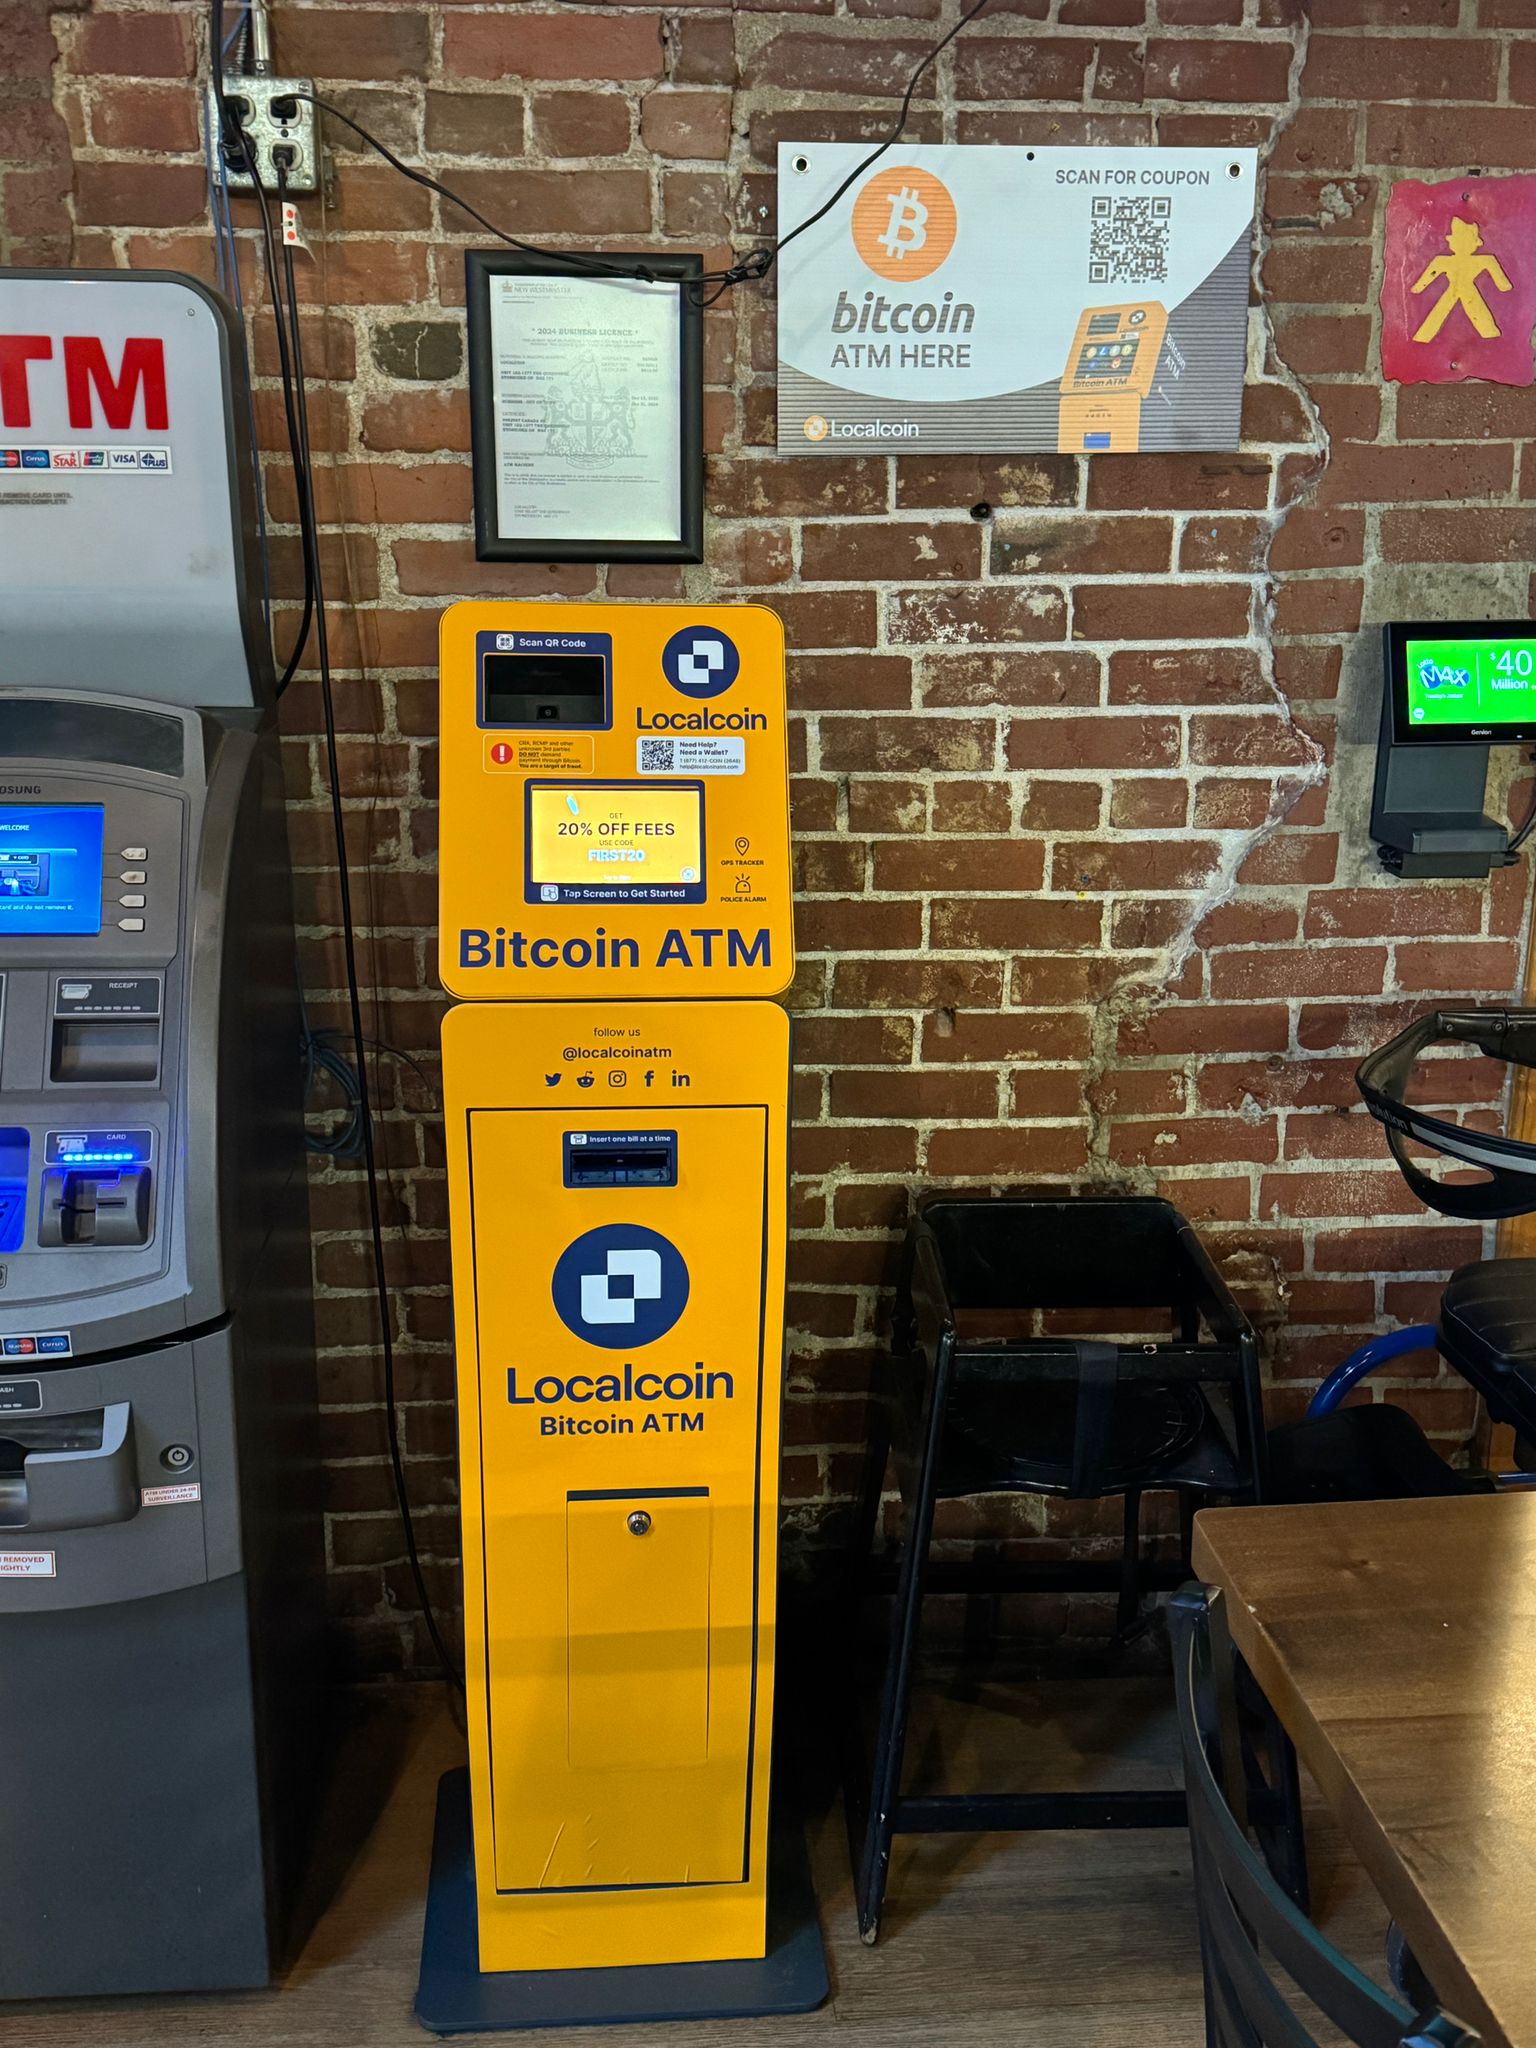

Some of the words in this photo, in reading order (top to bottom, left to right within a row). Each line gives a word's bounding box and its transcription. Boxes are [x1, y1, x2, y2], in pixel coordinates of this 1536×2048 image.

[1056, 169, 1102, 185] SCAN
[1105, 169, 1137, 185] FOR
[1139, 170, 1211, 186] COUPON
[831, 290, 976, 334] bitcoin
[558, 328, 597, 336] BUSINESS
[830, 343, 891, 368] ATM
[900, 343, 971, 368] HERE
[1072, 379, 1105, 389] Bitcoin
[1105, 377, 1128, 387] ATM
[830, 417, 920, 438] Localcoin
[53, 457, 78, 468] STAR
[112, 454, 136, 464] VISA
[148, 458, 167, 468] PLUS
[519, 638, 543, 647] Scan
[544, 639, 559, 648] QR
[561, 639, 587, 648] Code
[1489, 649, 1533, 677] $40
[1419, 665, 1467, 689] MAX
[1491, 678, 1528, 690] Million
[636, 707, 768, 731] Localcoin
[558, 822, 593, 836] 20%
[598, 822, 630, 836] OFF
[634, 823, 675, 836] FEES
[587, 849, 646, 862] FIRST20
[563, 889, 581, 899] Tap
[583, 889, 617, 898] Screen
[618, 890, 629, 898] to
[630, 889, 648, 898] Get
[649, 889, 686, 898] Started
[459, 928, 640, 968] Bitcoin
[656, 928, 772, 968] ATM
[593, 1026, 625, 1037] follow
[628, 1028, 641, 1037] us
[562, 1046, 672, 1062] @localcoinatm
[106, 1133, 127, 1141] CARD
[589, 1135, 611, 1143] Insert
[627, 1135, 639, 1143] bill
[639, 1135, 647, 1143] at
[507, 1362, 734, 1404] Localcoin
[540, 1414, 634, 1436] Bitcoin
[641, 1412, 704, 1433] ATM
[147, 1493, 193, 1502] SURVEILLANCE
